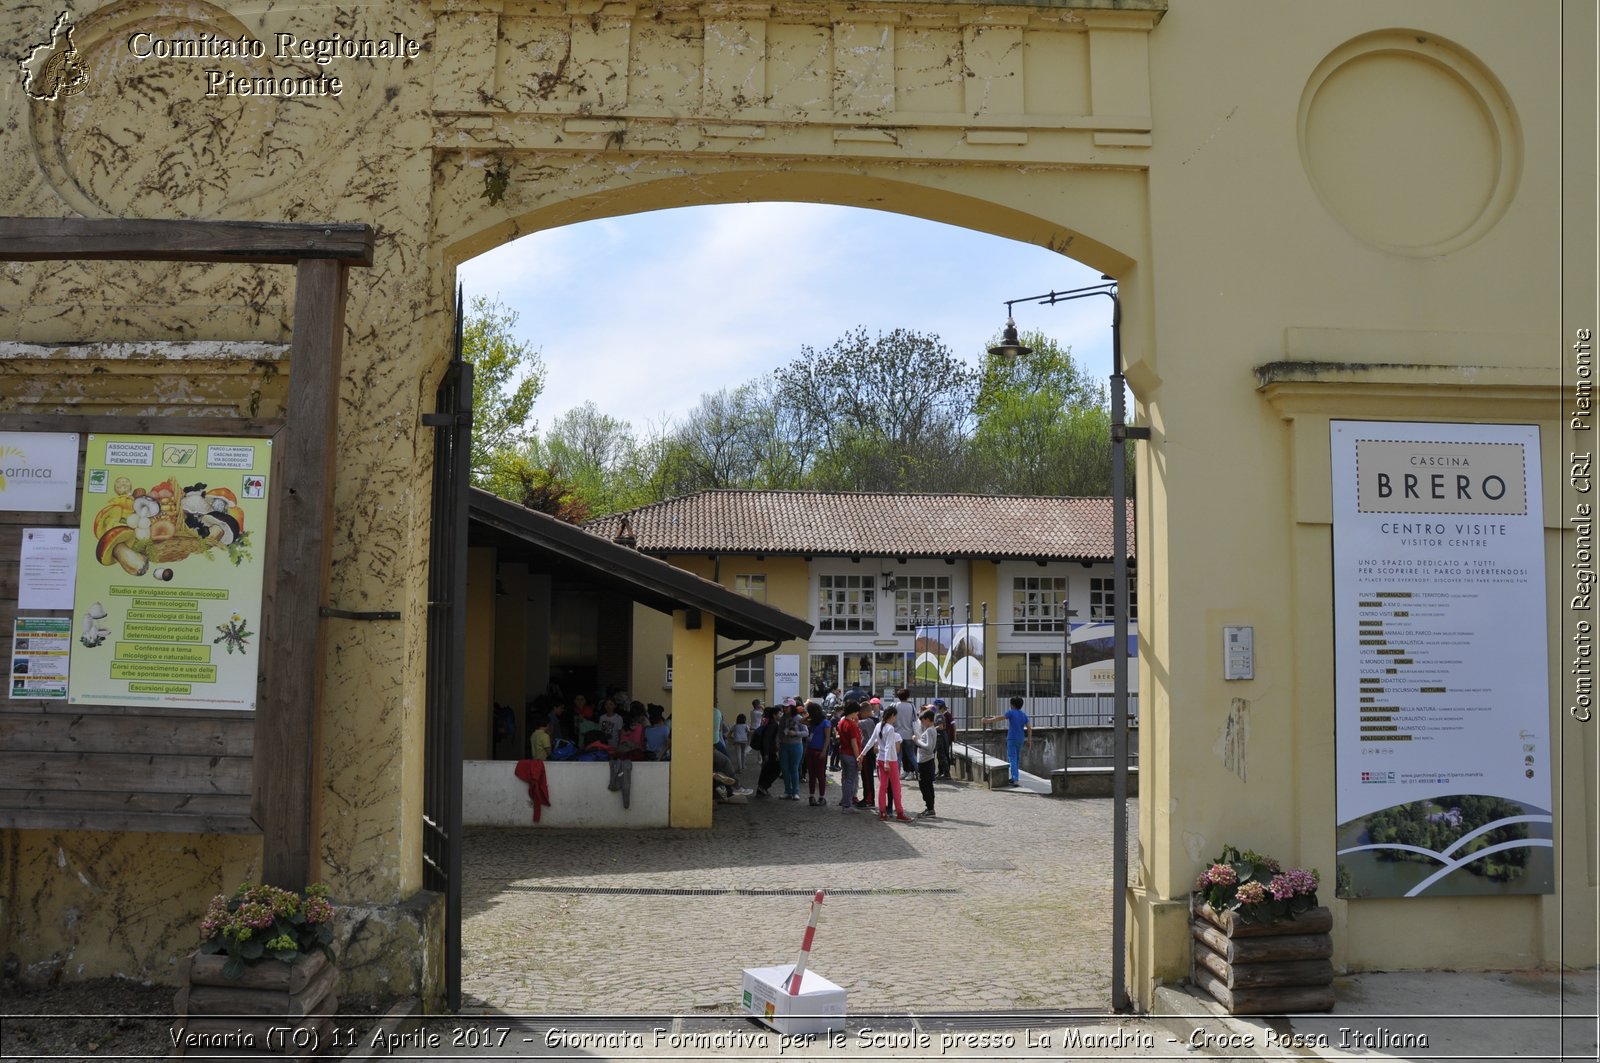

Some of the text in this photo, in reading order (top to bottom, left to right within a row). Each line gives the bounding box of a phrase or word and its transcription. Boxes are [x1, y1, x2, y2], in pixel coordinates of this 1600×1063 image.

[1410, 456, 1470, 466] CASCINA
[6, 468, 52, 478] arnica
[1378, 473, 1506, 500] BRERO
[1381, 523, 1506, 535] CENTRO VISITE
[138, 589, 177, 597] divulgazione
[158, 600, 195, 608] micologiche
